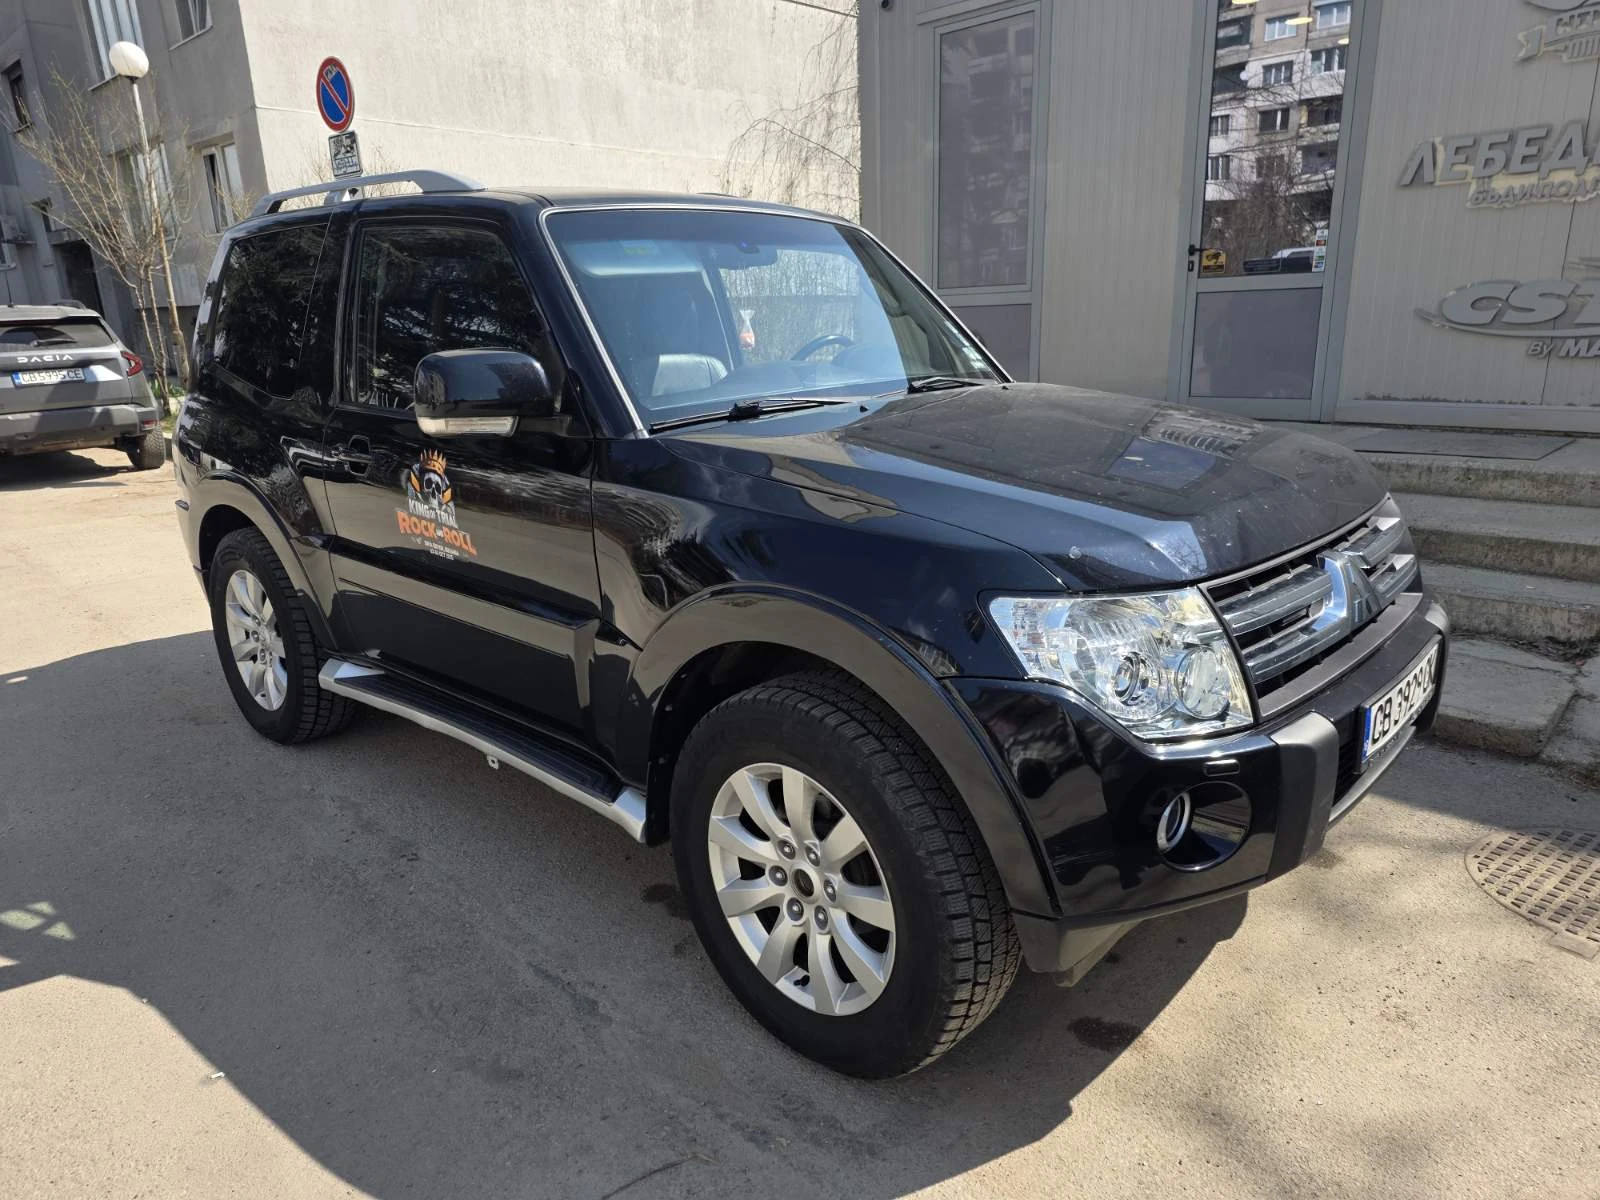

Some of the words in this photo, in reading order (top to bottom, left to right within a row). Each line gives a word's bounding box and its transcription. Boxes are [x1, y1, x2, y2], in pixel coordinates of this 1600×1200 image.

[16, 354, 73, 363] DACIA
[397, 510, 438, 538] ROCK
[442, 526, 477, 556] ROLL
